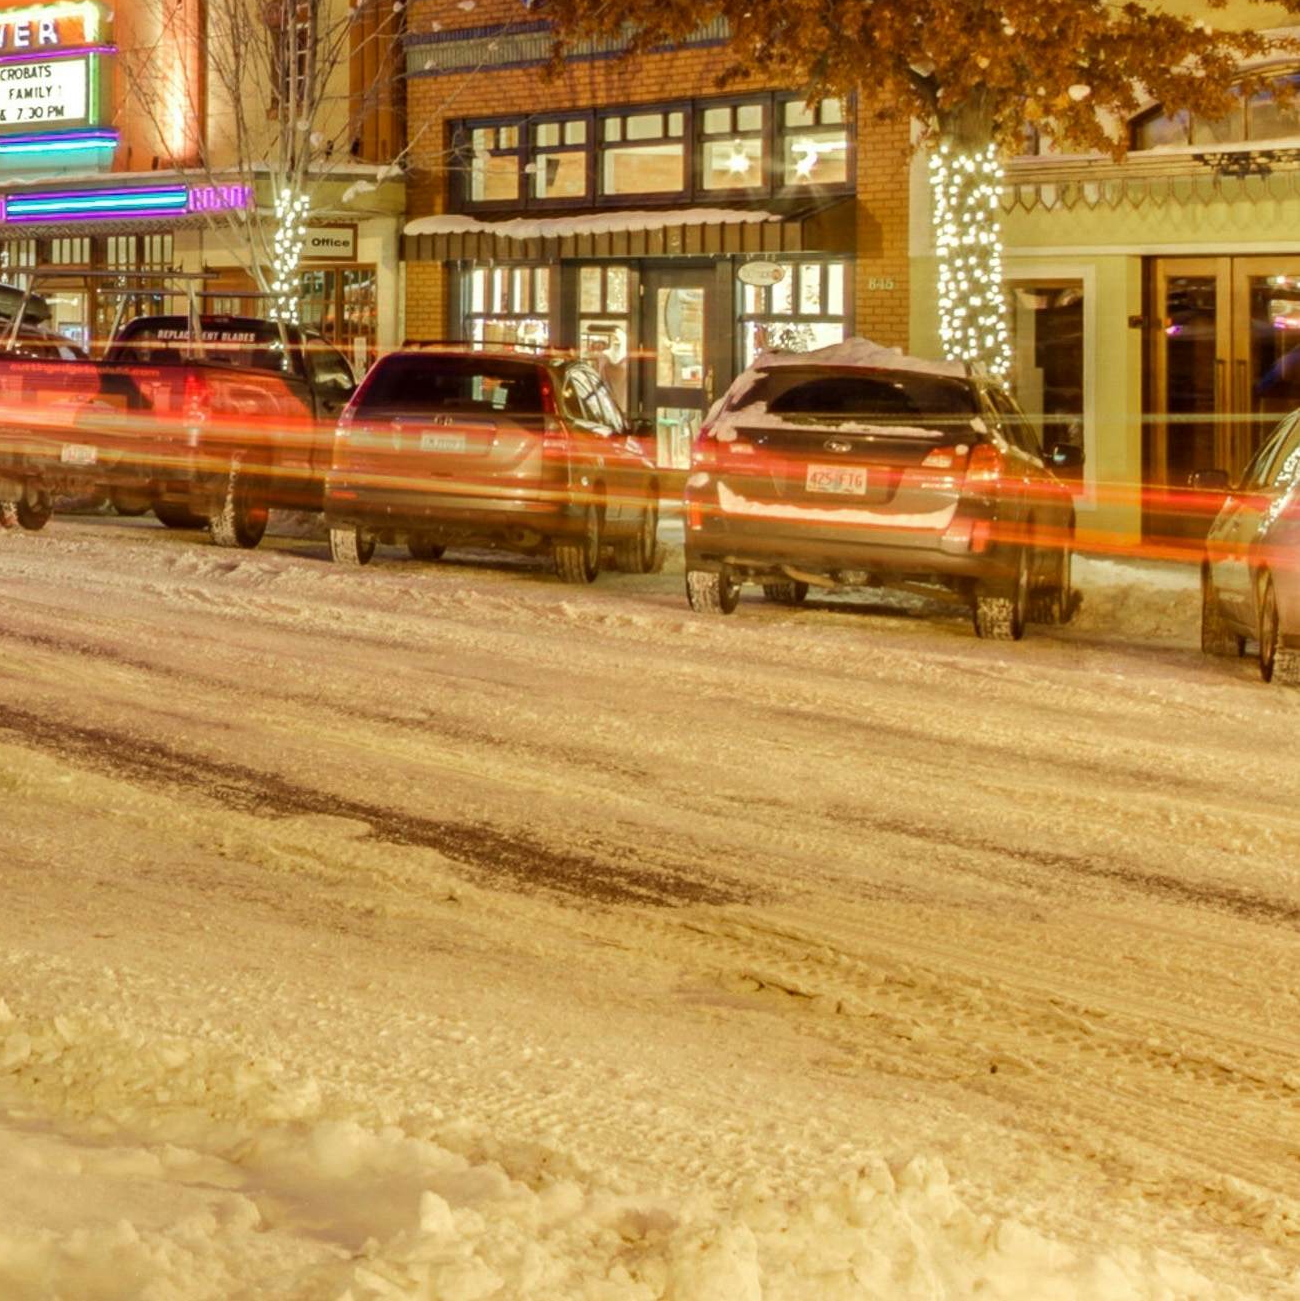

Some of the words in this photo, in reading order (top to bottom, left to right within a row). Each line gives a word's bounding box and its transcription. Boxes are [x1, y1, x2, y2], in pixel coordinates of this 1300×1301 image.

[47, 105, 65, 117] PM
[311, 237, 350, 248] Office
[157, 329, 219, 341] REPLACENT
[221, 332, 256, 342] BLADES
